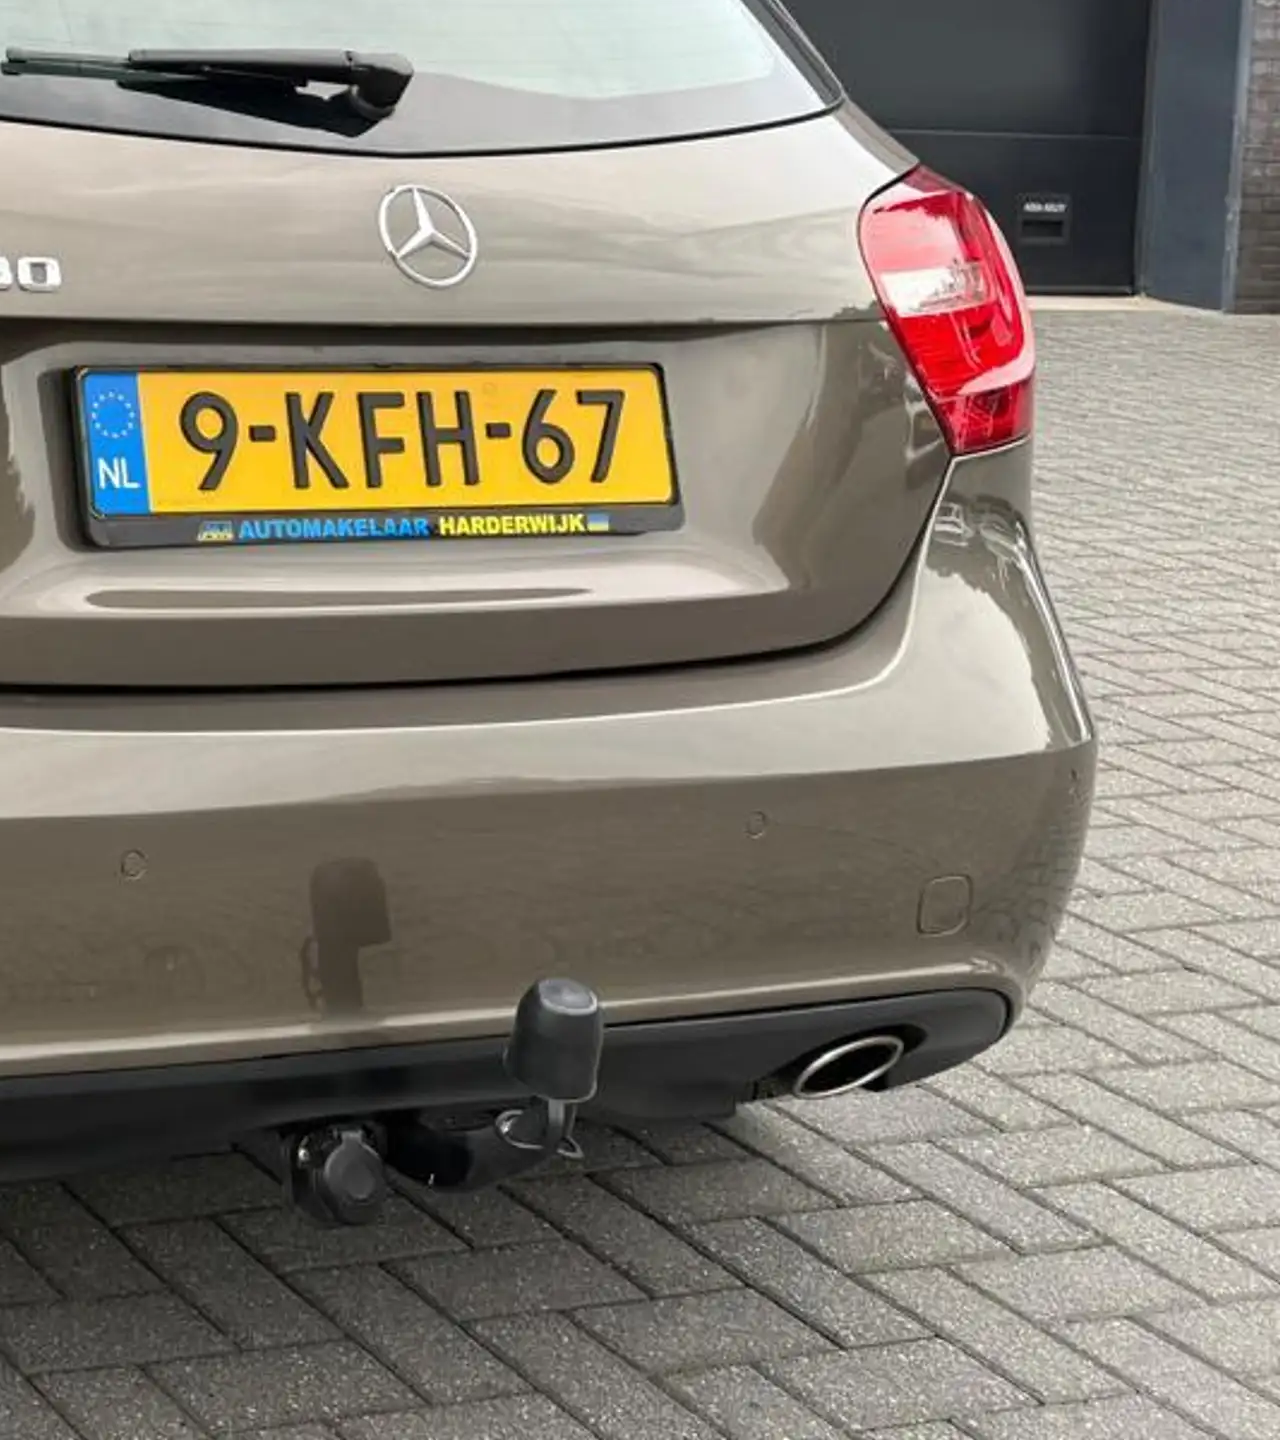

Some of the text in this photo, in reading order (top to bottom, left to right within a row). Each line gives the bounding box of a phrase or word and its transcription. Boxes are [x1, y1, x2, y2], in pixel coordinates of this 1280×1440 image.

[180, 387, 626, 492] 9-KFH-67
[97, 455, 140, 490] NL
[239, 517, 429, 539] AUTOMAKELAAR
[439, 514, 586, 535] HARDERWIJK
